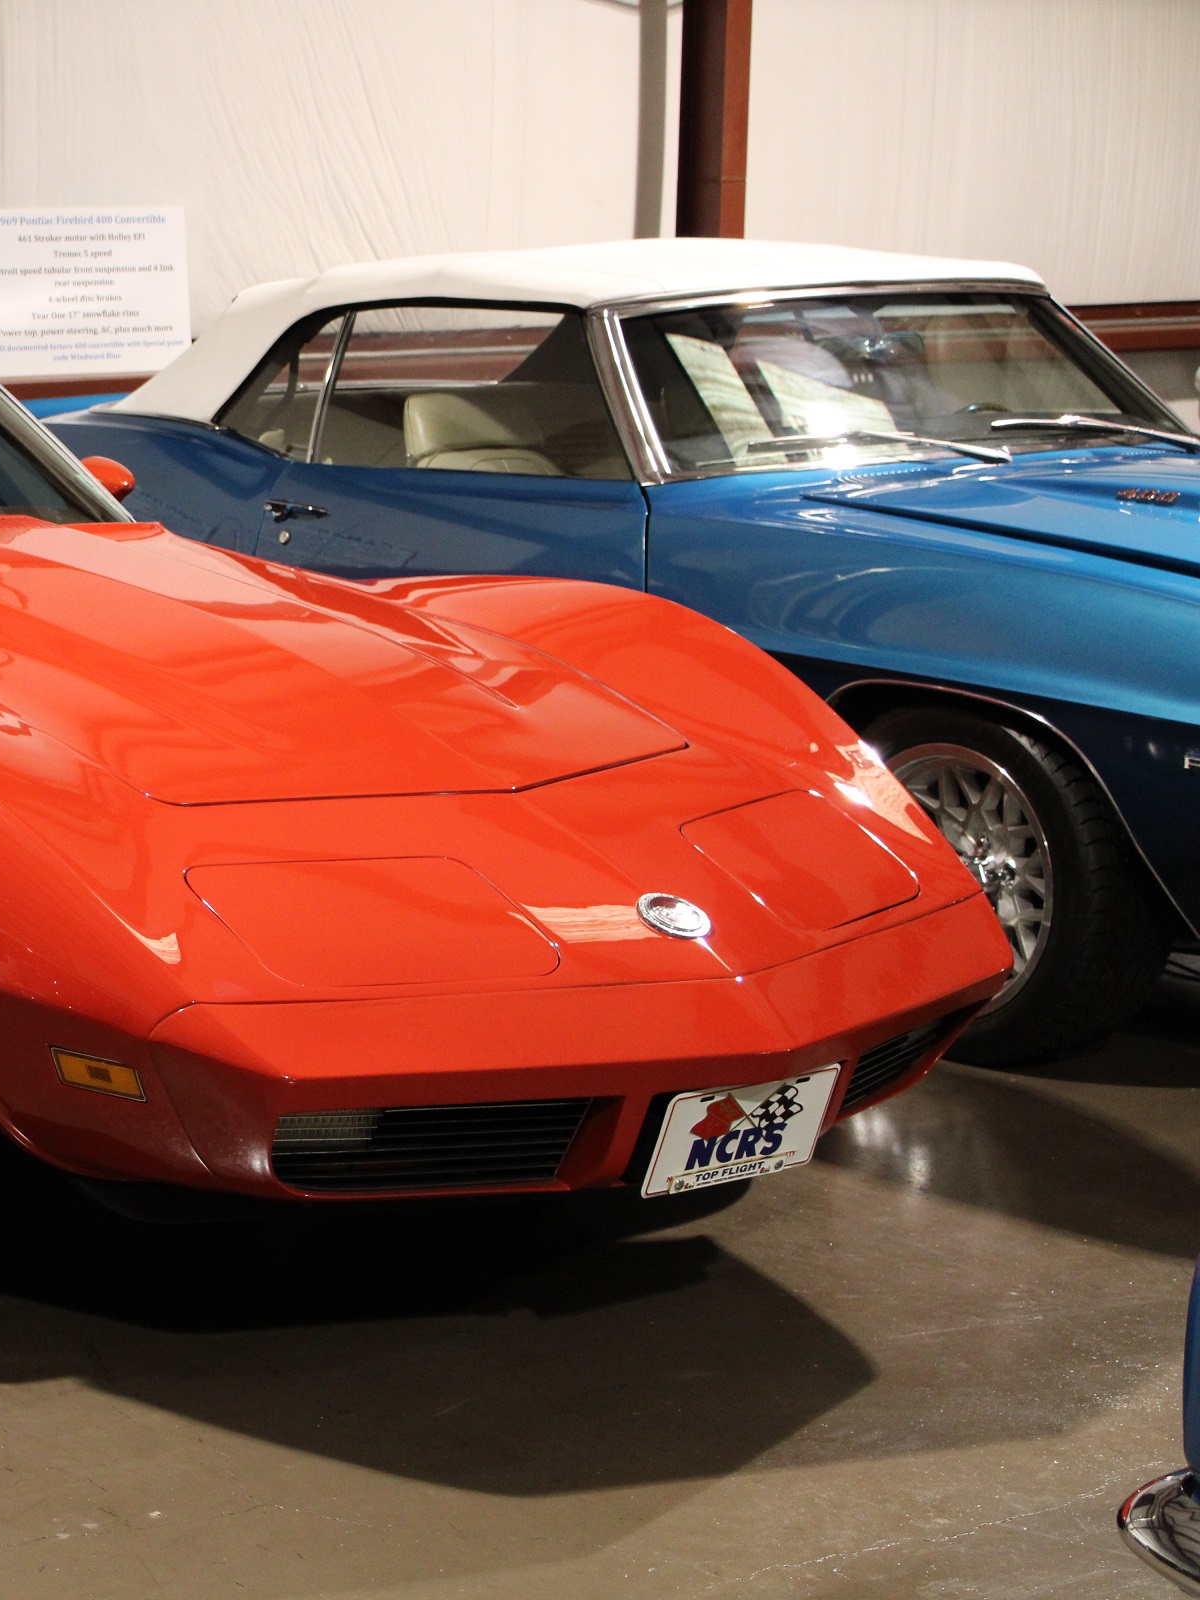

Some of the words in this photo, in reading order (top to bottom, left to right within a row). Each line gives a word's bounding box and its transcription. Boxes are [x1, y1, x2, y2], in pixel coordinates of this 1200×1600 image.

[20, 217, 54, 225] Pontiac
[56, 216, 94, 224] Firebird
[96, 216, 113, 224] 400
[115, 215, 166, 224] Convertible
[684, 1122, 788, 1171] NCRS
[696, 1172, 718, 1182] TOP
[721, 1161, 765, 1176] FLIGHT
